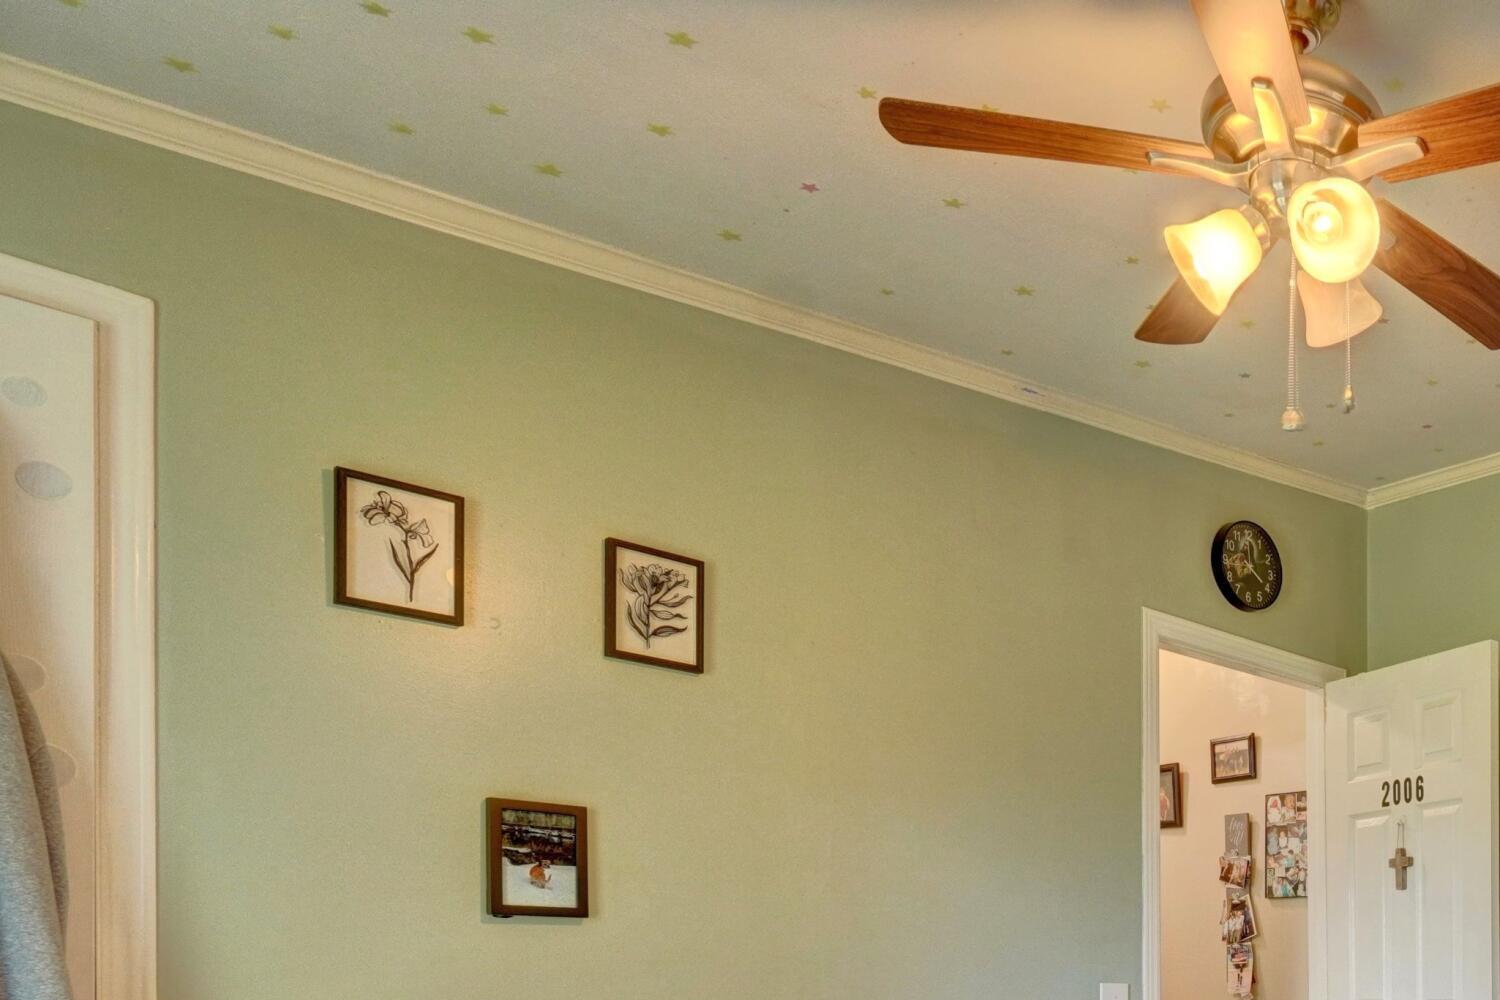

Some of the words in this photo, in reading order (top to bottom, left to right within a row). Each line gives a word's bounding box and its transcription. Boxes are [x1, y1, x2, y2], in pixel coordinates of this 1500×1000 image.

[1233, 530, 1240, 540] 11
[1244, 529, 1252, 539] 12
[1225, 540, 1235, 551] 10
[1257, 539, 1262, 549] 1
[1222, 554, 1228, 565] 9
[1265, 554, 1271, 565] 2
[1227, 571, 1233, 582] 8
[1268, 570, 1273, 580] 3
[1235, 584, 1241, 594] 7
[1264, 583, 1270, 593] 4
[1246, 592, 1251, 602] 6
[1256, 591, 1262, 602] 5
[1381, 775, 1424, 808] 2006
